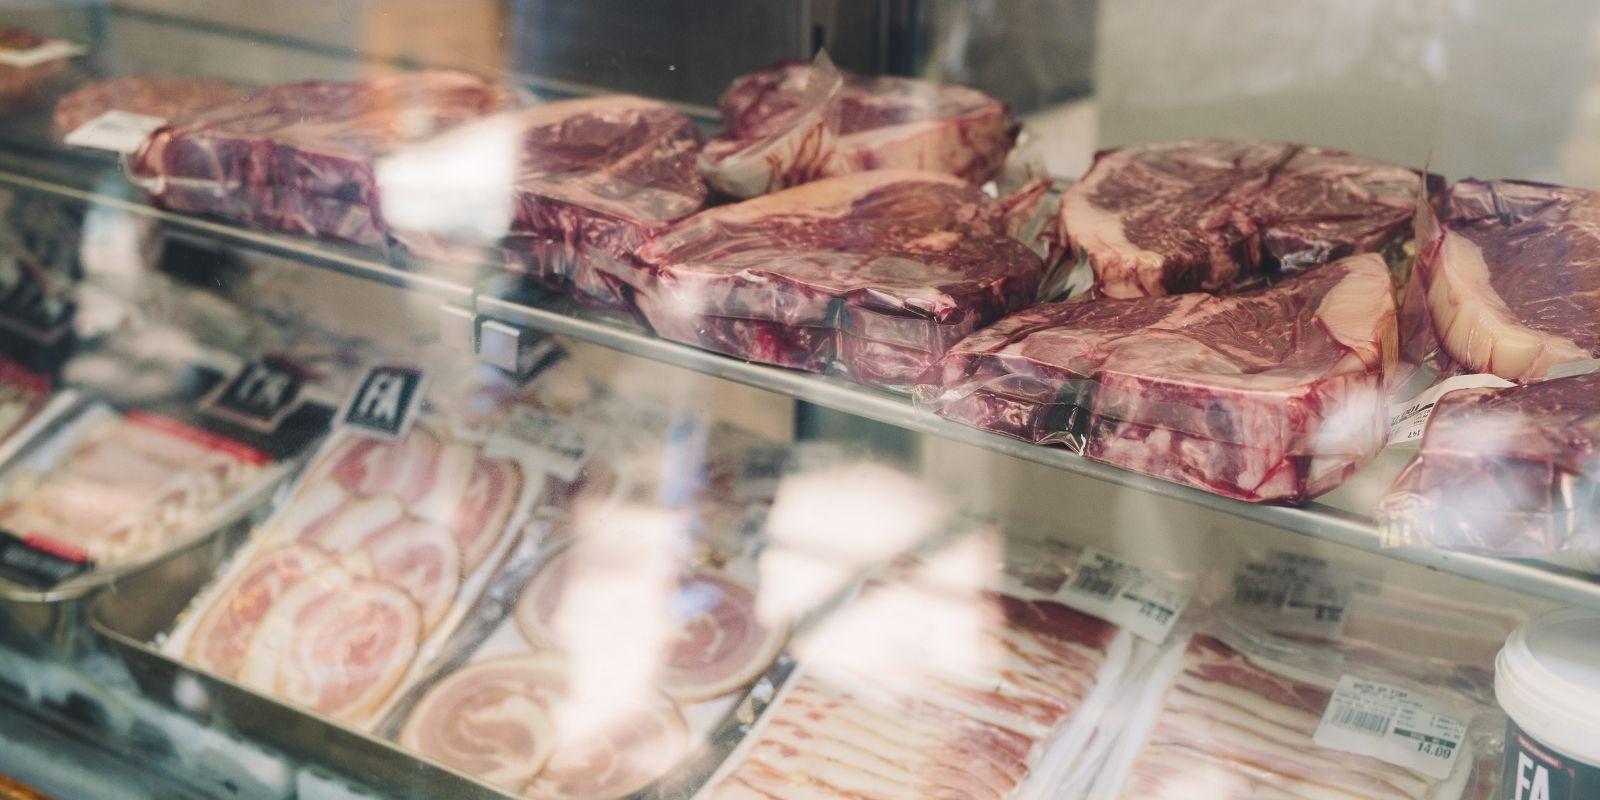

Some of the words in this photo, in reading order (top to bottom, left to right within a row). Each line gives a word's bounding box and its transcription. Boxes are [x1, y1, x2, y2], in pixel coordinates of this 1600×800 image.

[359, 371, 404, 420] FA
[1417, 742, 1451, 760] 14.09
[1514, 751, 1551, 800] FA
